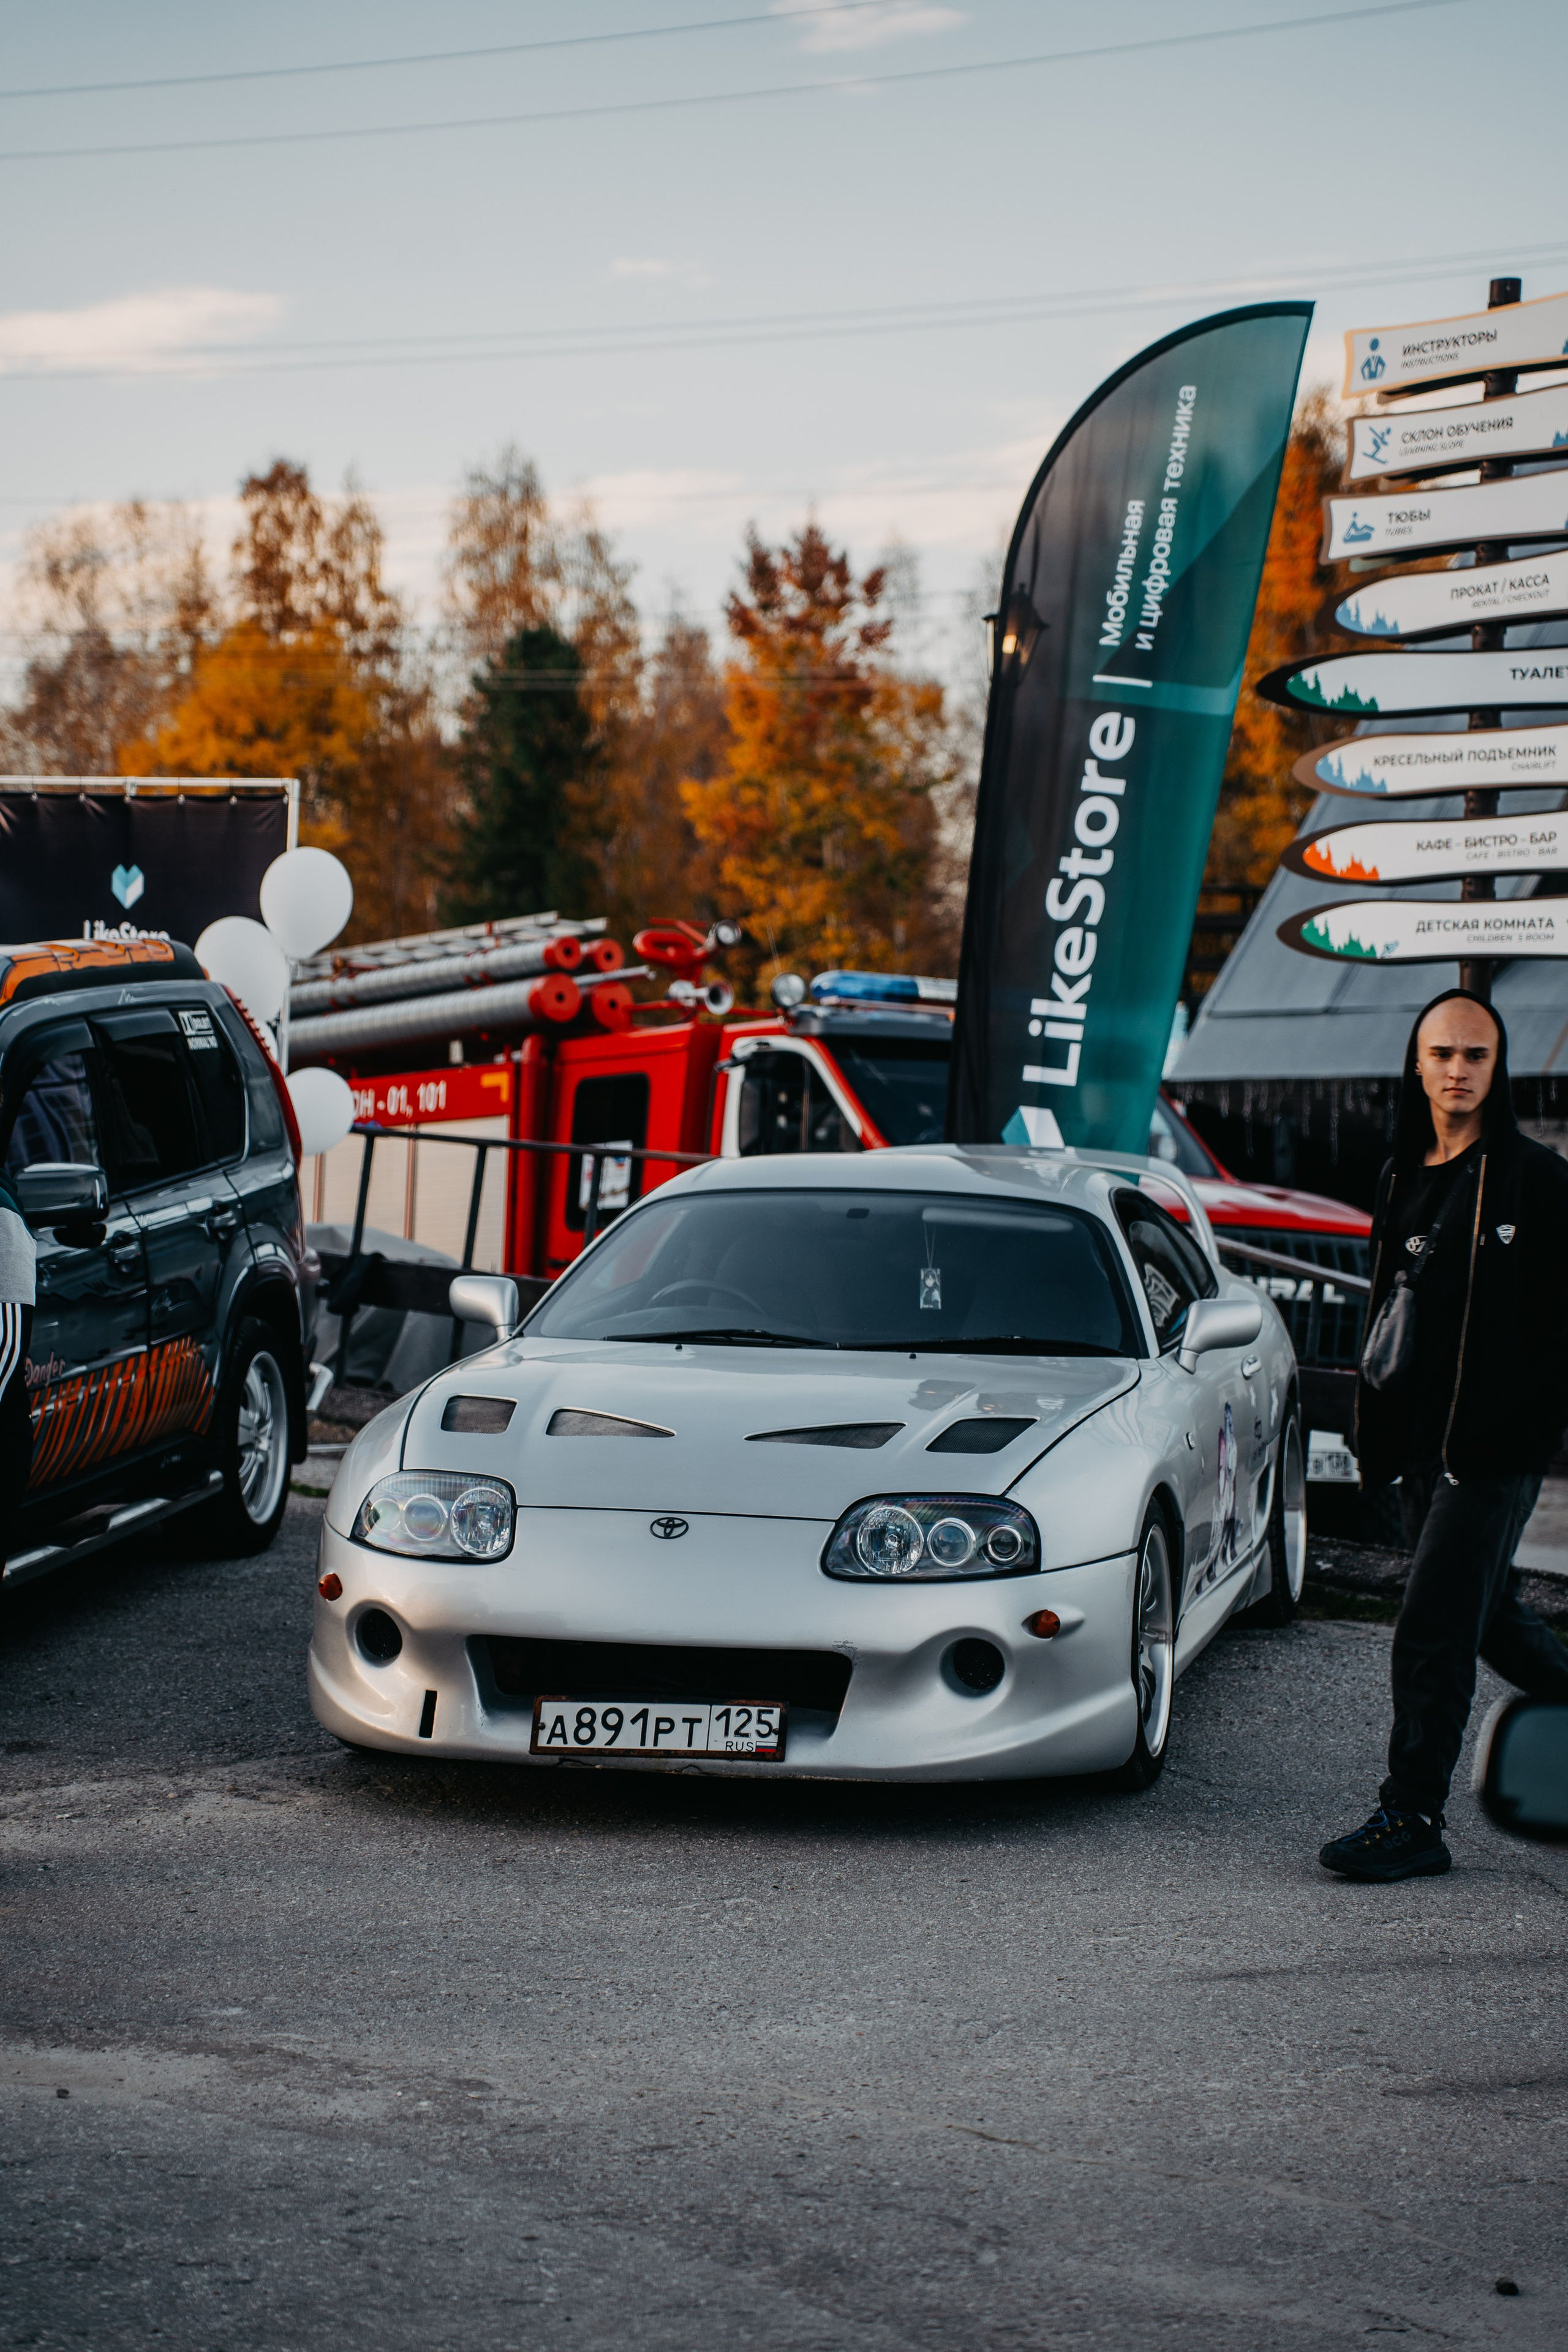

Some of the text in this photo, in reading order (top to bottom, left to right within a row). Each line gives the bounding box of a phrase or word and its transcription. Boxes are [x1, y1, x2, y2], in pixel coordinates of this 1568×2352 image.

[1402, 329, 1498, 356] ИНСТРУКТОРЫ
[1401, 417, 1513, 443] СКЛОН ОБУЧЕНИЯ
[1135, 385, 1197, 650] и цифровая техника
[1386, 508, 1431, 524] ТЮБЫ
[1099, 499, 1145, 646] Мобильная
[1450, 581, 1498, 601] ПРОКАТ
[1509, 573, 1550, 590] КАССА
[1373, 744, 1557, 767] КРЕСЕЛЬНЫЙ ПОДЪЕМНИК
[1415, 838, 1453, 852] КАФЕ
[1464, 833, 1518, 849] БИСТРО
[1529, 831, 1558, 844] БАР
[1022, 711, 1136, 1087] LikeStore
[1416, 917, 1555, 933] ДЕТСКАЯ КОМНАТА
[387, 1084, 413, 1119] 01,
[417, 1080, 447, 1113] 101
[715, 1708, 774, 1739] 125
[725, 1740, 754, 1752] RUS
